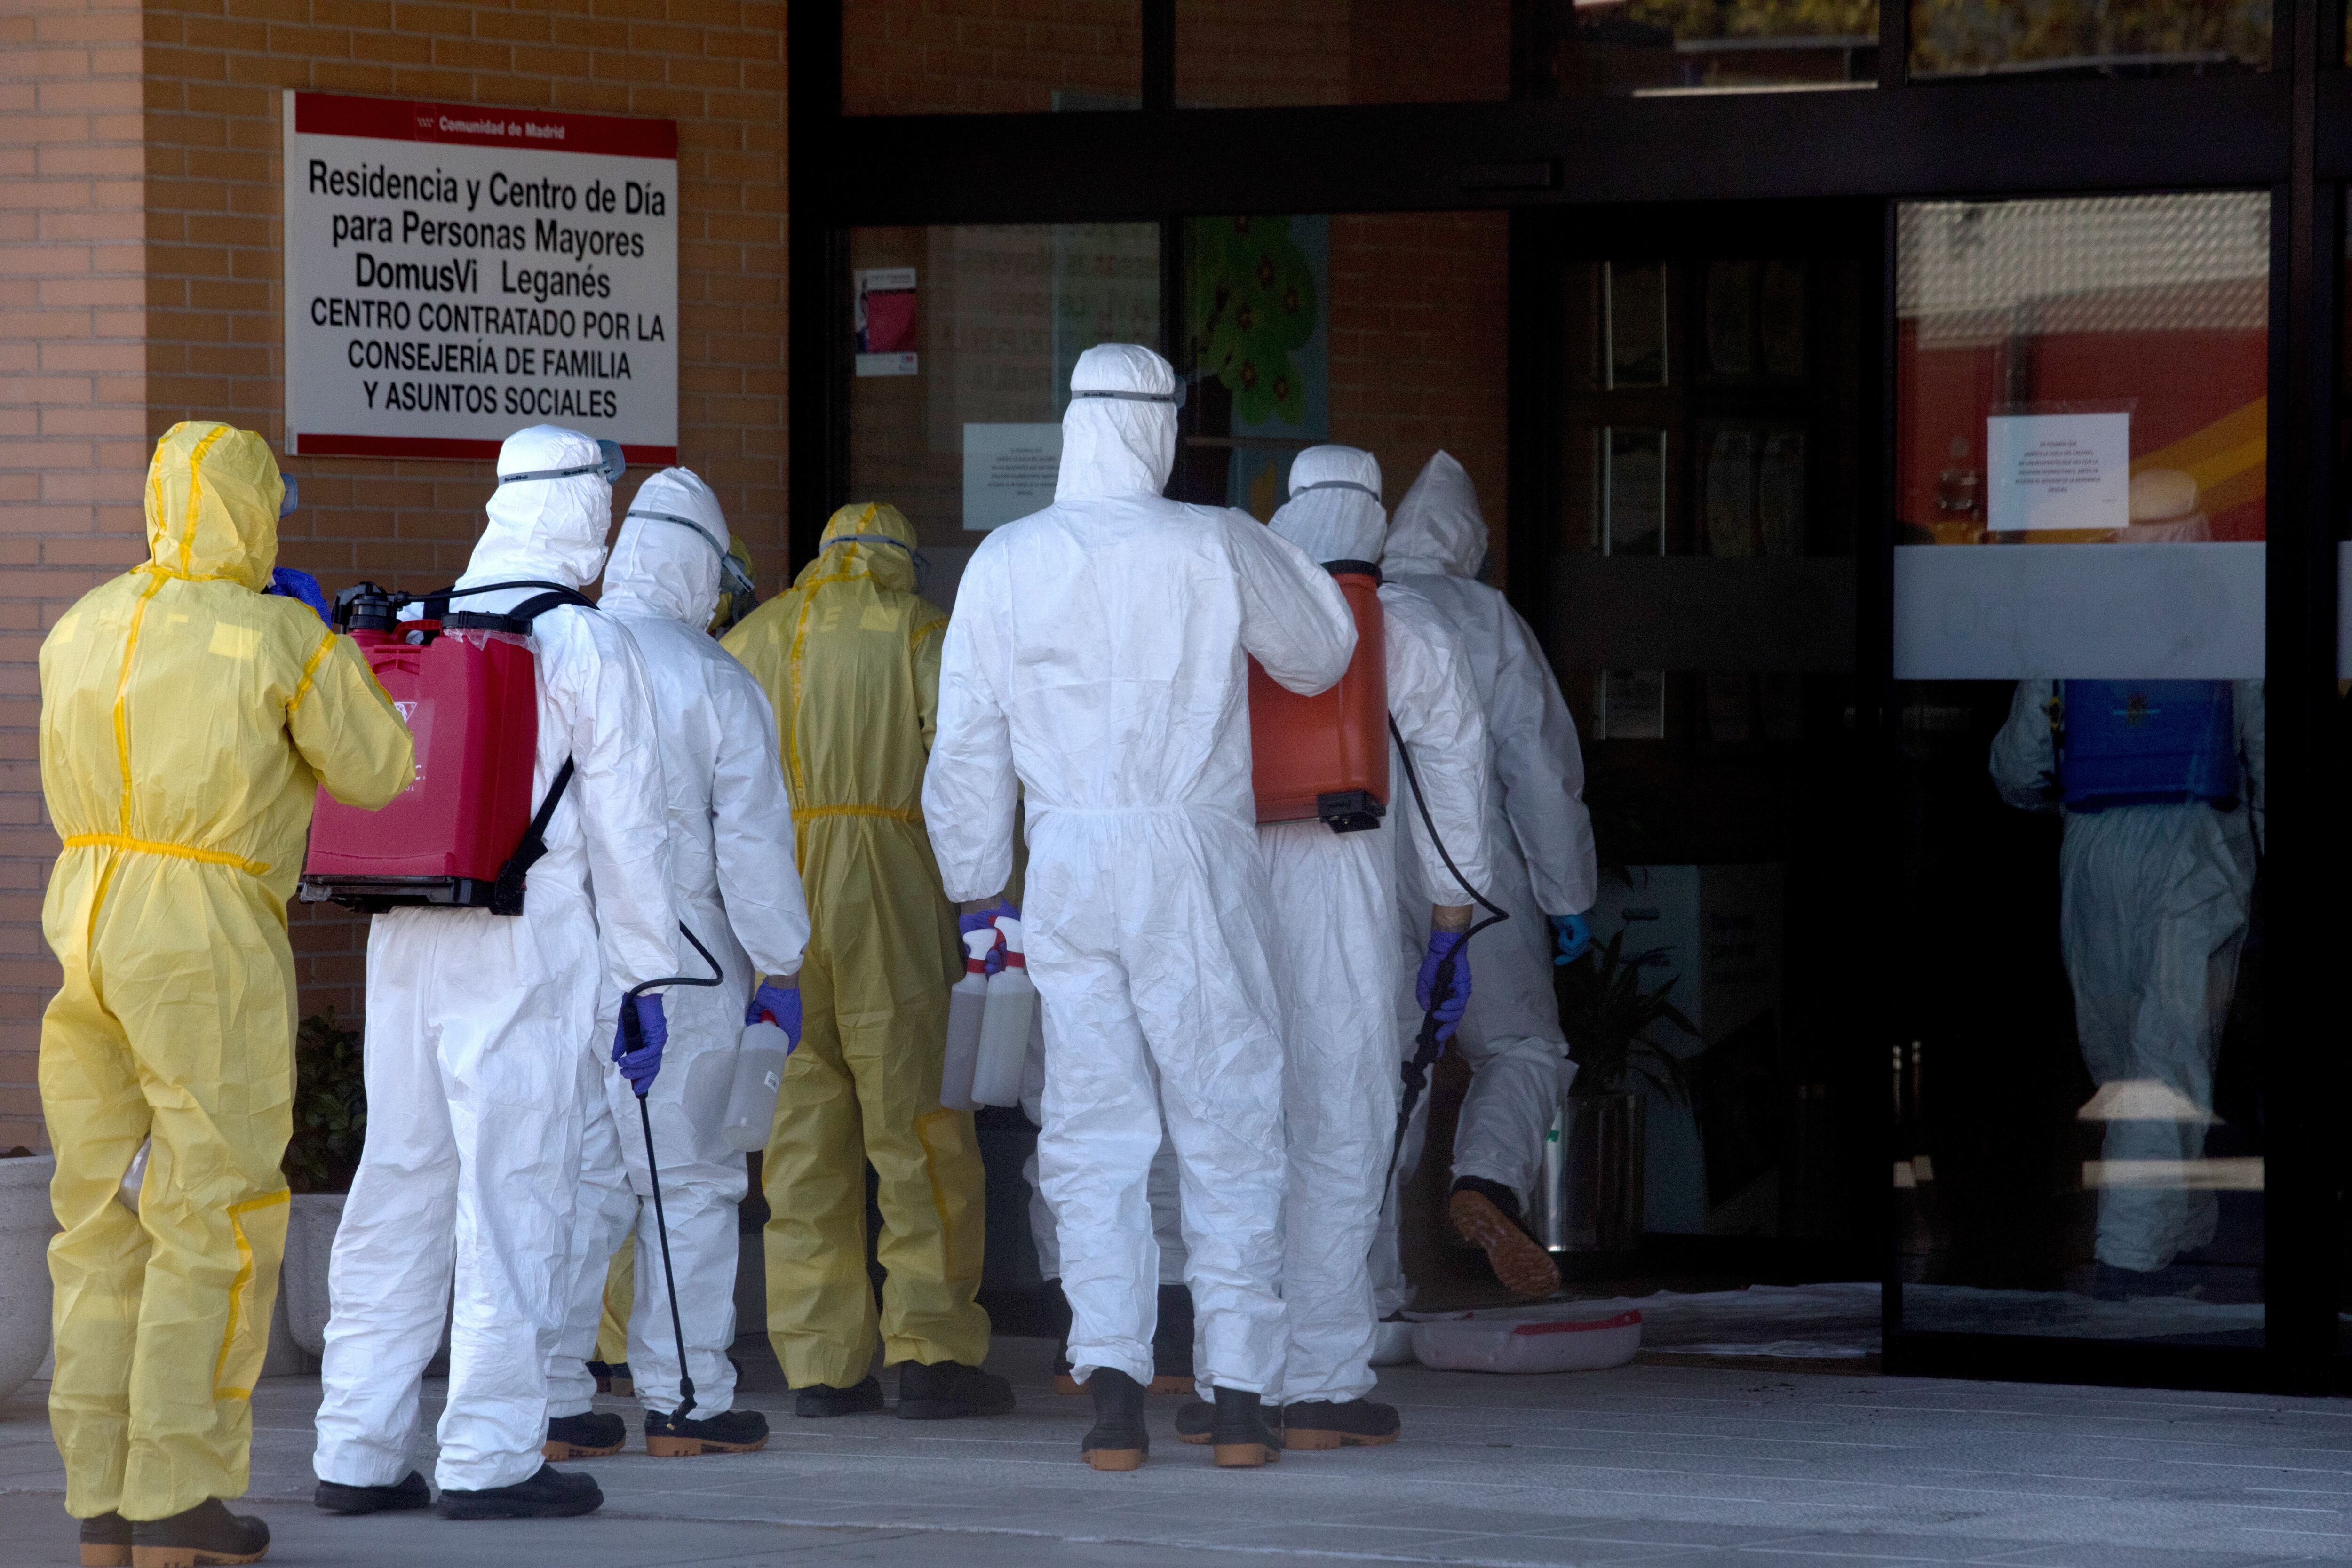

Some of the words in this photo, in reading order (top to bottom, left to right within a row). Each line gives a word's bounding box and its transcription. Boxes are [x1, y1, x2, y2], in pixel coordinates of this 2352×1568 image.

[439, 115, 505, 135] Comunidad
[507, 121, 522, 136] de
[525, 122, 565, 140] Madrid
[309, 159, 458, 203] Residencia
[466, 179, 481, 212] y
[489, 171, 577, 211] Centro
[585, 179, 616, 214] de
[625, 181, 665, 217] Día
[333, 214, 393, 248] para
[403, 210, 526, 251] Personas
[535, 218, 644, 262] Mayores
[356, 252, 478, 294] DomusVi
[502, 260, 611, 304] Leganés
[310, 297, 411, 331] CENTRO
[418, 302, 576, 338] CONTRATADO
[583, 311, 630, 340] POR
[638, 314, 665, 342] LA
[348, 339, 498, 374] CONSEJERÍA
[505, 347, 535, 375] DE
[543, 349, 631, 379] FAMILIA
[363, 381, 378, 409] Y
[385, 382, 498, 414] ASUNTOS
[504, 386, 617, 419] SOCIALES
